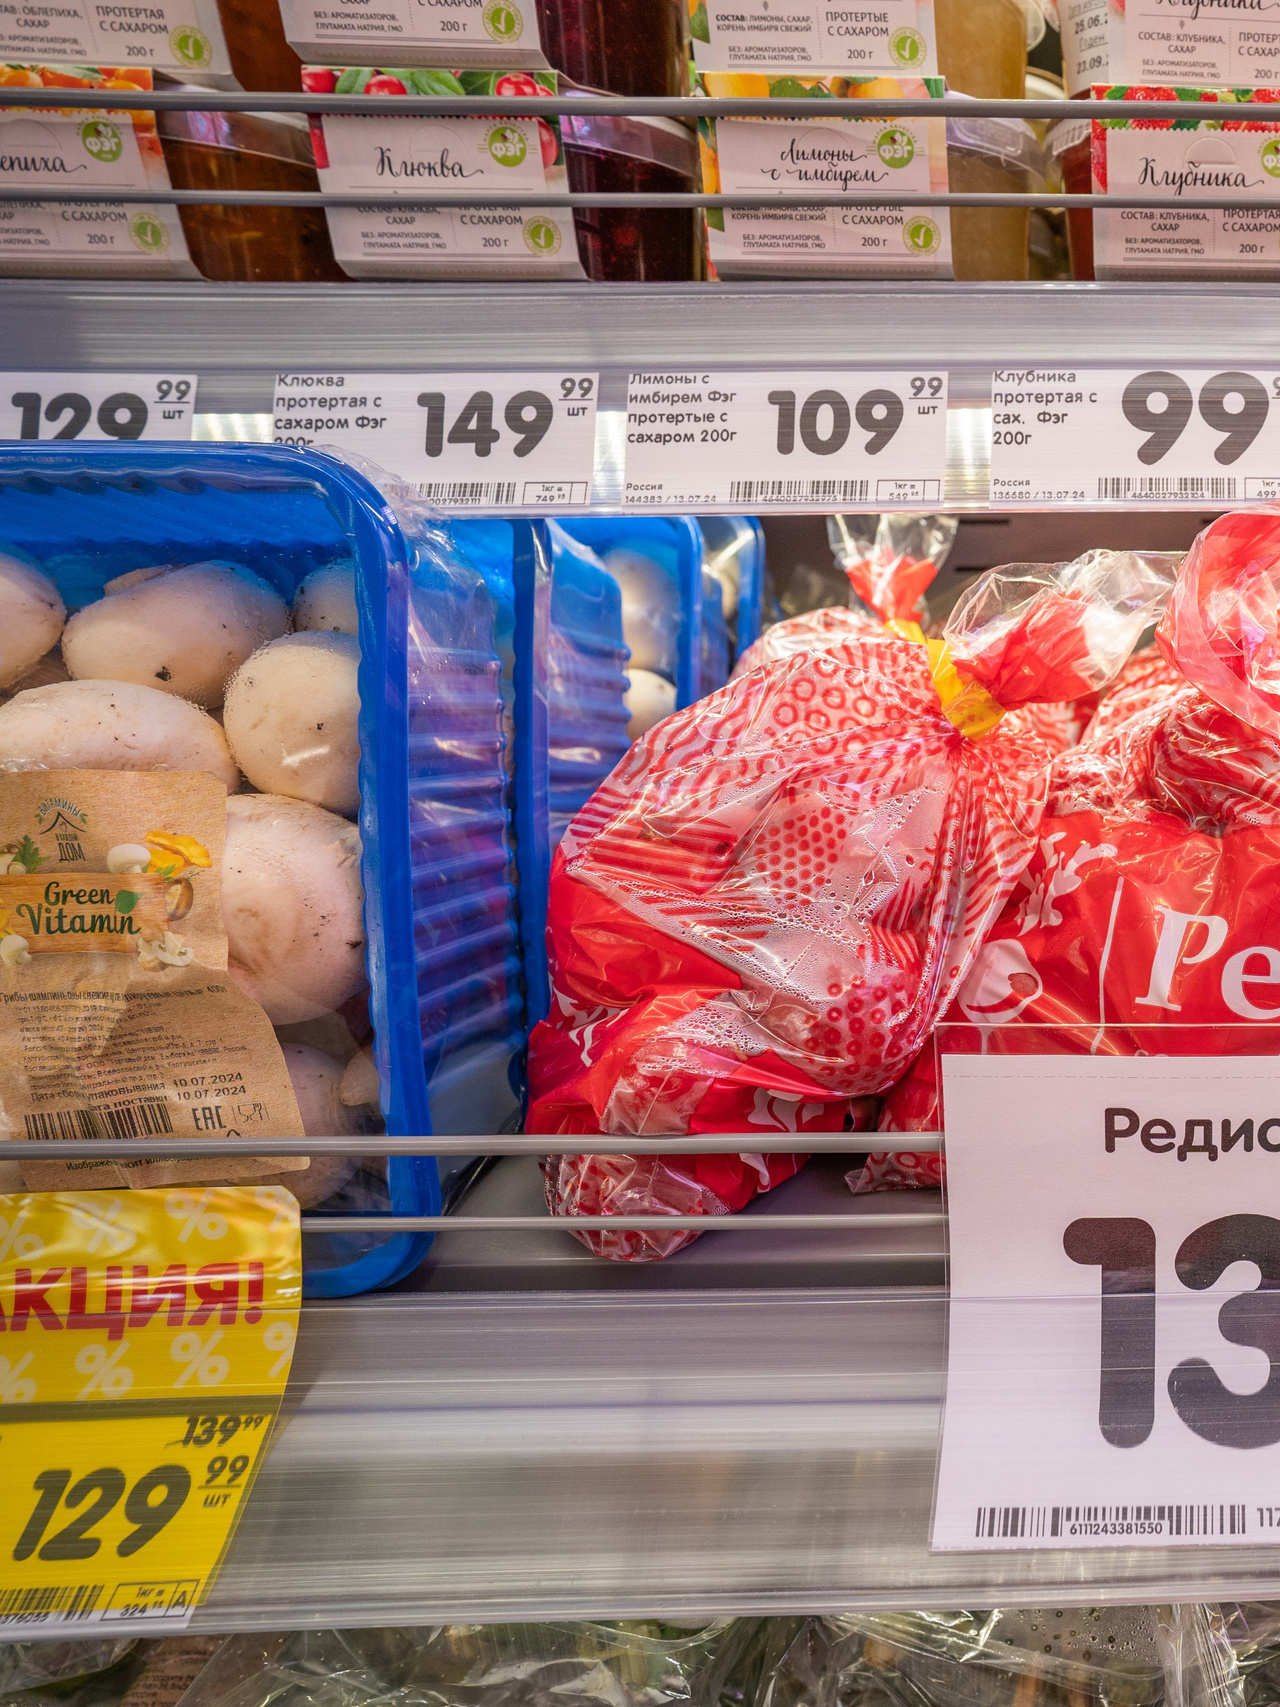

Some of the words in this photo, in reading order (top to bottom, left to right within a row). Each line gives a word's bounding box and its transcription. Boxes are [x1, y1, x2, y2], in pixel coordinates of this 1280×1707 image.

[96, 6, 164, 19] ПРОТЕРТАЯ
[749, 15, 785, 23] ЛИМОНЫ,
[826, 12, 888, 22] ПРОТЕРТЫЕ
[16, 19, 49, 28] САХАР
[100, 21, 108, 31] С
[110, 22, 169, 34] САХАРОМ
[780, 24, 811, 32] СВЕЖИЙ
[828, 26, 834, 35] С
[836, 26, 889, 37] САХАРОМ
[1138, 32, 1174, 41] СОСТАВ:
[1176, 34, 1225, 45] КЛУБНИКА,
[126, 46, 147, 56] 200
[847, 50, 866, 58] 200
[1168, 45, 1196, 54] САХАР
[86, 138, 118, 152] ФЭГ
[491, 142, 524, 157] ФЭГ
[781, 138, 867, 164] Лимоны
[880, 145, 912, 160] ФЭГ
[374, 147, 484, 178] Клюква
[786, 162, 889, 191] имбирем
[1138, 157, 1264, 195] Клубника
[386, 216, 415, 224] САХАР
[1121, 211, 1157, 219] СОСТАВ:
[1160, 212, 1210, 221] КЛУБНИКА,
[1223, 209, 1280, 219] ПРОТЕРТАЯ
[1151, 223, 1179, 231] САХАР
[278, 374, 344, 387] Клюква
[630, 374, 697, 385] Лимоны
[702, 375, 709, 384] с
[994, 371, 1076, 383] Клубника
[156, 380, 190, 400] 99
[560, 378, 593, 398] 99
[910, 377, 943, 397] 99
[276, 396, 367, 411] протертая
[373, 397, 381, 407] с
[629, 392, 702, 406] имбирем
[708, 391, 736, 402] Фэг
[994, 392, 1082, 404] протертая
[1090, 393, 1097, 402] с
[12, 392, 148, 439] 129
[163, 410, 184, 419] шт
[567, 407, 587, 417] шт
[918, 405, 938, 415] шт
[275, 417, 349, 432] сахаром
[356, 415, 386, 428] Фэг
[417, 391, 553, 457] 149
[628, 412, 715, 426] протертые
[720, 412, 728, 422] с
[768, 389, 904, 455] 109
[994, 413, 1025, 423] сах.
[1037, 411, 1069, 424] Фэг
[1122, 371, 1269, 465] 99
[628, 432, 694, 445] сахаром
[700, 430, 737, 443] 200г
[993, 432, 1031, 445] 200г
[626, 483, 662, 491] Россия
[625, 495, 662, 504] 144383
[674, 495, 716, 503] 13.07.24
[993, 491, 1031, 499] 136680
[1042, 491, 1085, 499] 13.07.24
[58, 842, 85, 862] ДОМ
[44, 881, 115, 906] Green
[16, 904, 141, 935] Vitamin
[174, 1073, 243, 1087] 10.07.2024
[177, 1085, 246, 1101] 10.07.2024
[0, 1262, 263, 1341] КЦИЯ!
[182, 1416, 241, 1448] 139
[243, 1417, 264, 1430] 99
[206, 1455, 249, 1485] 99
[203, 1494, 230, 1507] шт
[13, 1464, 191, 1561] 129
[1070, 1522, 1163, 1535] 6111243381550
[120, 1604, 148, 1617] 324
